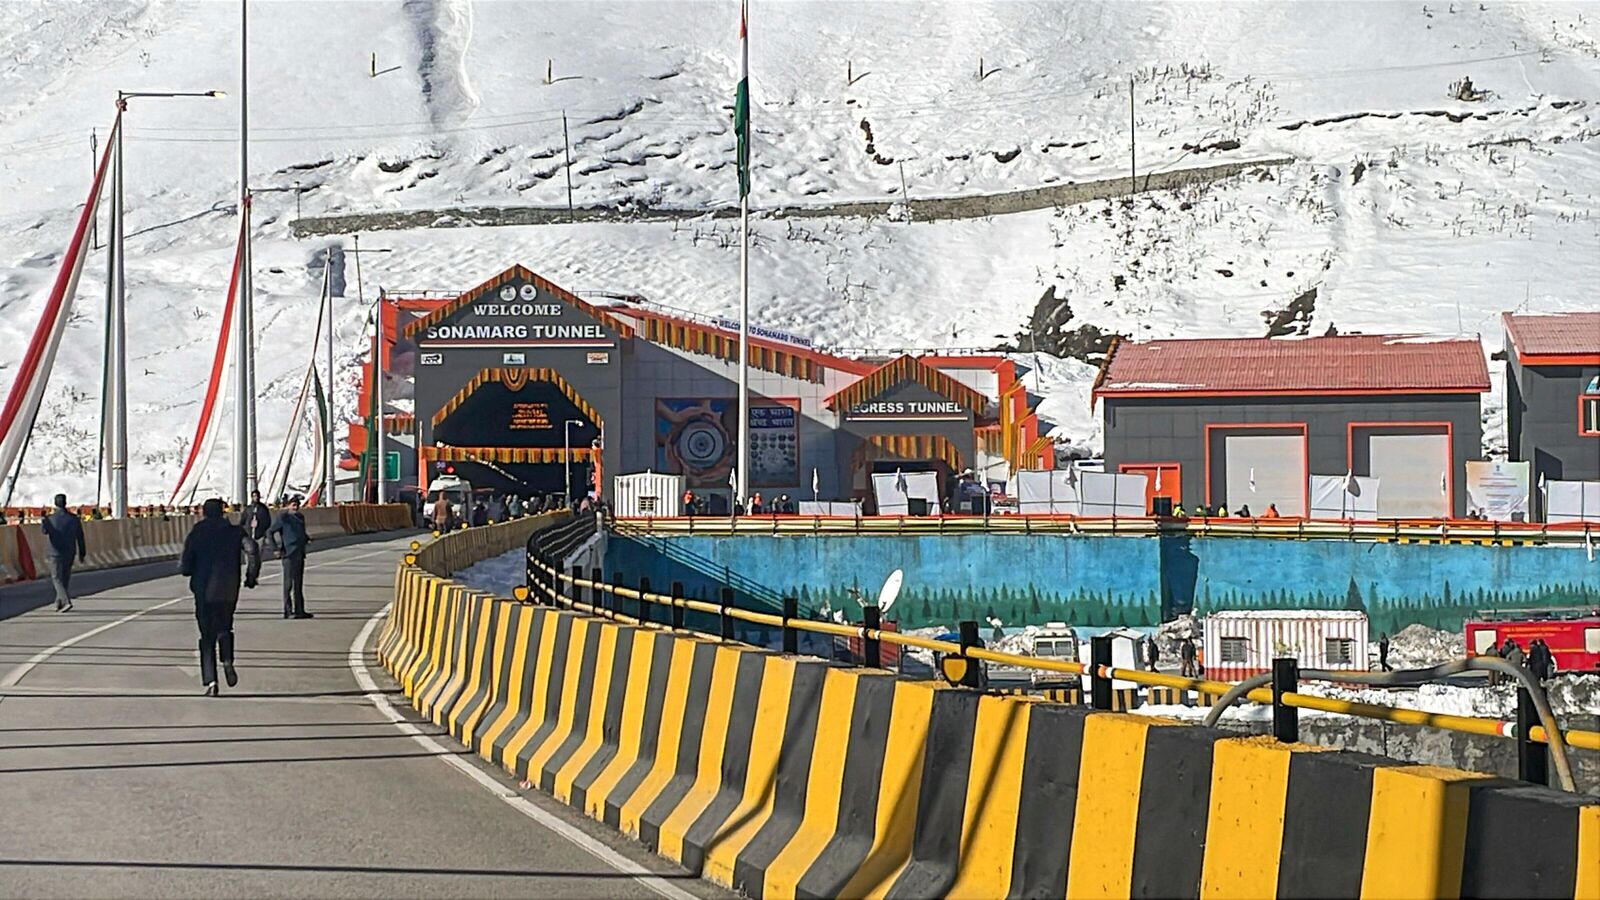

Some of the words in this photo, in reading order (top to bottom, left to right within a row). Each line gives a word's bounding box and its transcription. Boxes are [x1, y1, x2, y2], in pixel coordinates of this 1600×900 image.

[473, 304, 562, 316] WELCOME
[427, 325, 528, 339] SONAMARG
[532, 325, 606, 338] TUNNEL
[719, 320, 740, 330] WELCO
[748, 326, 756, 335] TO
[757, 328, 789, 342] SONAMARG
[790, 335, 811, 347] TUNNEL
[852, 402, 904, 413] EGRESS
[908, 402, 962, 413] TUNNEL
